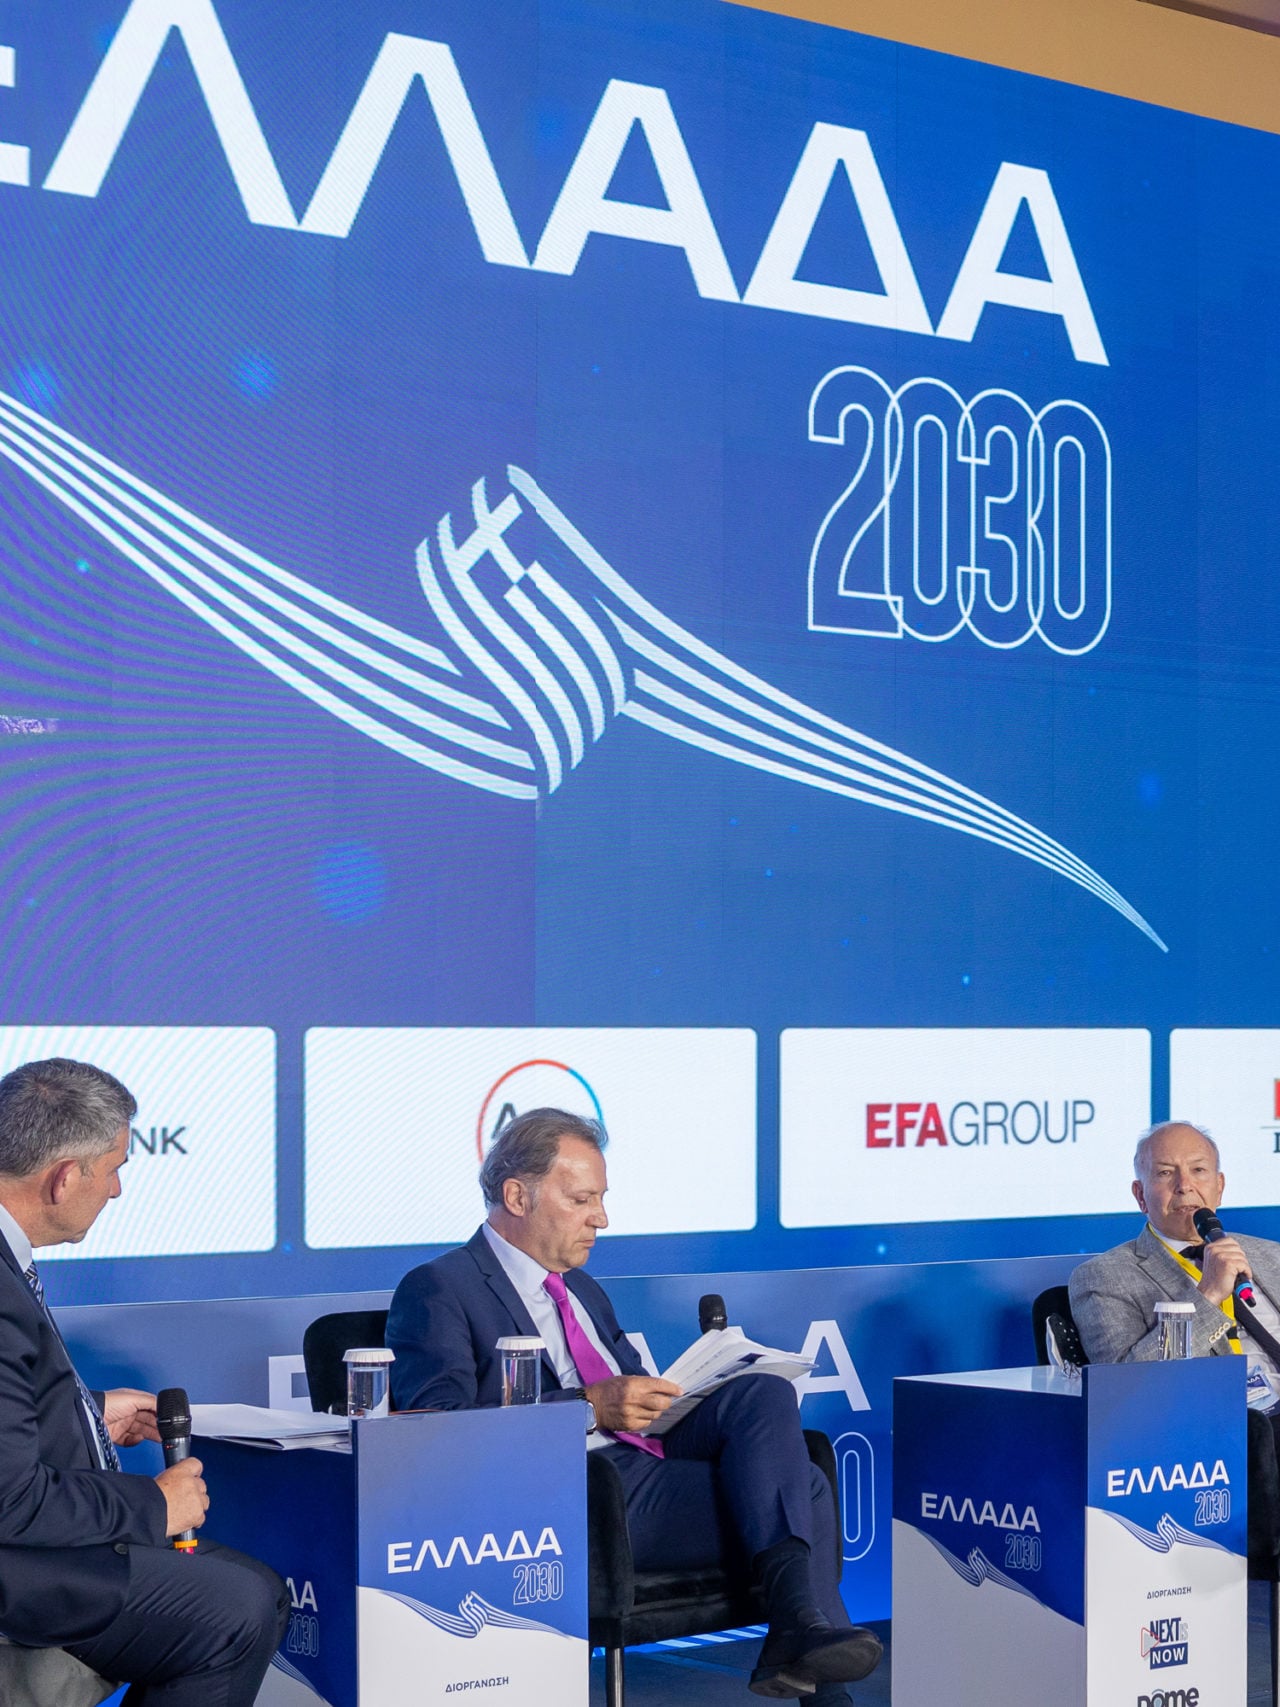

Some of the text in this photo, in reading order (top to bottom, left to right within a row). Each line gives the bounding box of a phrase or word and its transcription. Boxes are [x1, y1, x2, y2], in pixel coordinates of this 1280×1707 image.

[0, 0, 1109, 366] ΛΛΑΔΑ
[808, 366, 1110, 655] 2030
[866, 1100, 1095, 1148] EFAGROUP
[1107, 1460, 1230, 1497] ΕΛΛΑΔΑ
[921, 1493, 1041, 1533] ΕΛΛΑΔΑ
[1195, 1488, 1231, 1526] 2030
[387, 1527, 562, 1573] ΕΛΛΑΔΑ
[1005, 1533, 1041, 1572] 2030
[513, 1561, 563, 1605] 2030
[1147, 1586, 1192, 1600] ΔΙΟΡΓΑΝΩΣΗ
[1150, 1617, 1181, 1643] NEXT
[1152, 1646, 1185, 1664] NOW
[445, 1676, 509, 1693] ΔΙΟΡΓΑΝΩΣΗ
